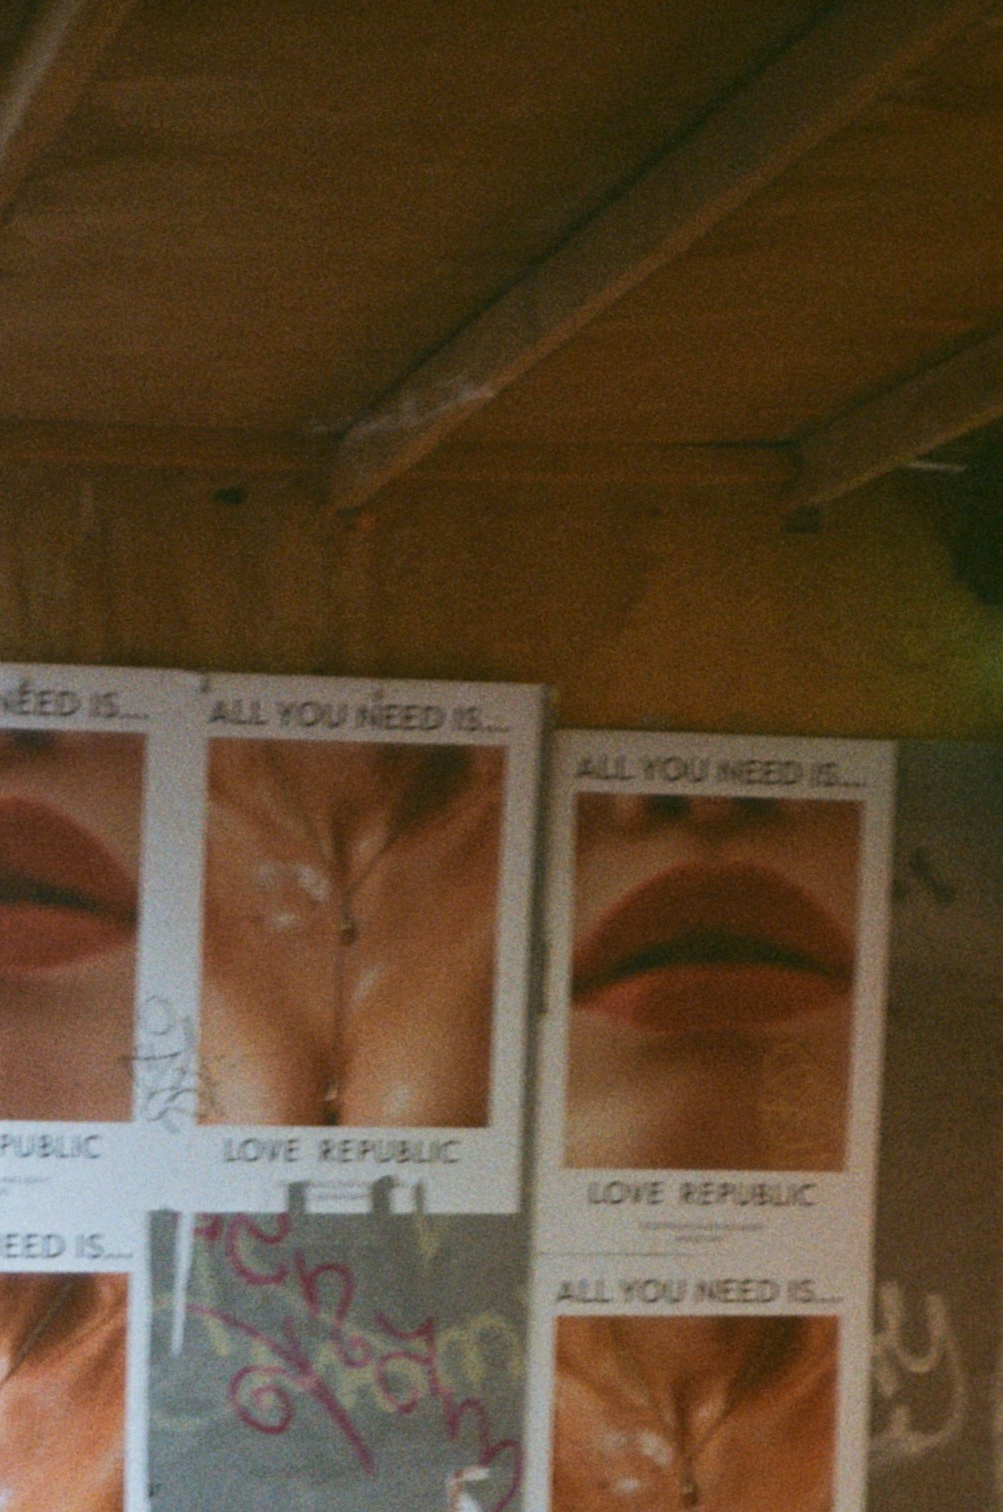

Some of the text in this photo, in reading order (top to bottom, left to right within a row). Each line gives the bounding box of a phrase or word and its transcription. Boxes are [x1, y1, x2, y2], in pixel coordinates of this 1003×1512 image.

[208, 700, 267, 725] ALL
[275, 701, 348, 728] YOU
[355, 703, 446, 731] NEED
[574, 755, 635, 780] ALL
[639, 756, 710, 783] YOU
[717, 759, 801, 785] NEED
[223, 1138, 461, 1164] LOVE REPUBLIC
[587, 1180, 817, 1207] LOVE REPUBLIC
[557, 1279, 613, 1303] ALL
[619, 1279, 688, 1303] YOU
[698, 1279, 781, 1304] NEED
